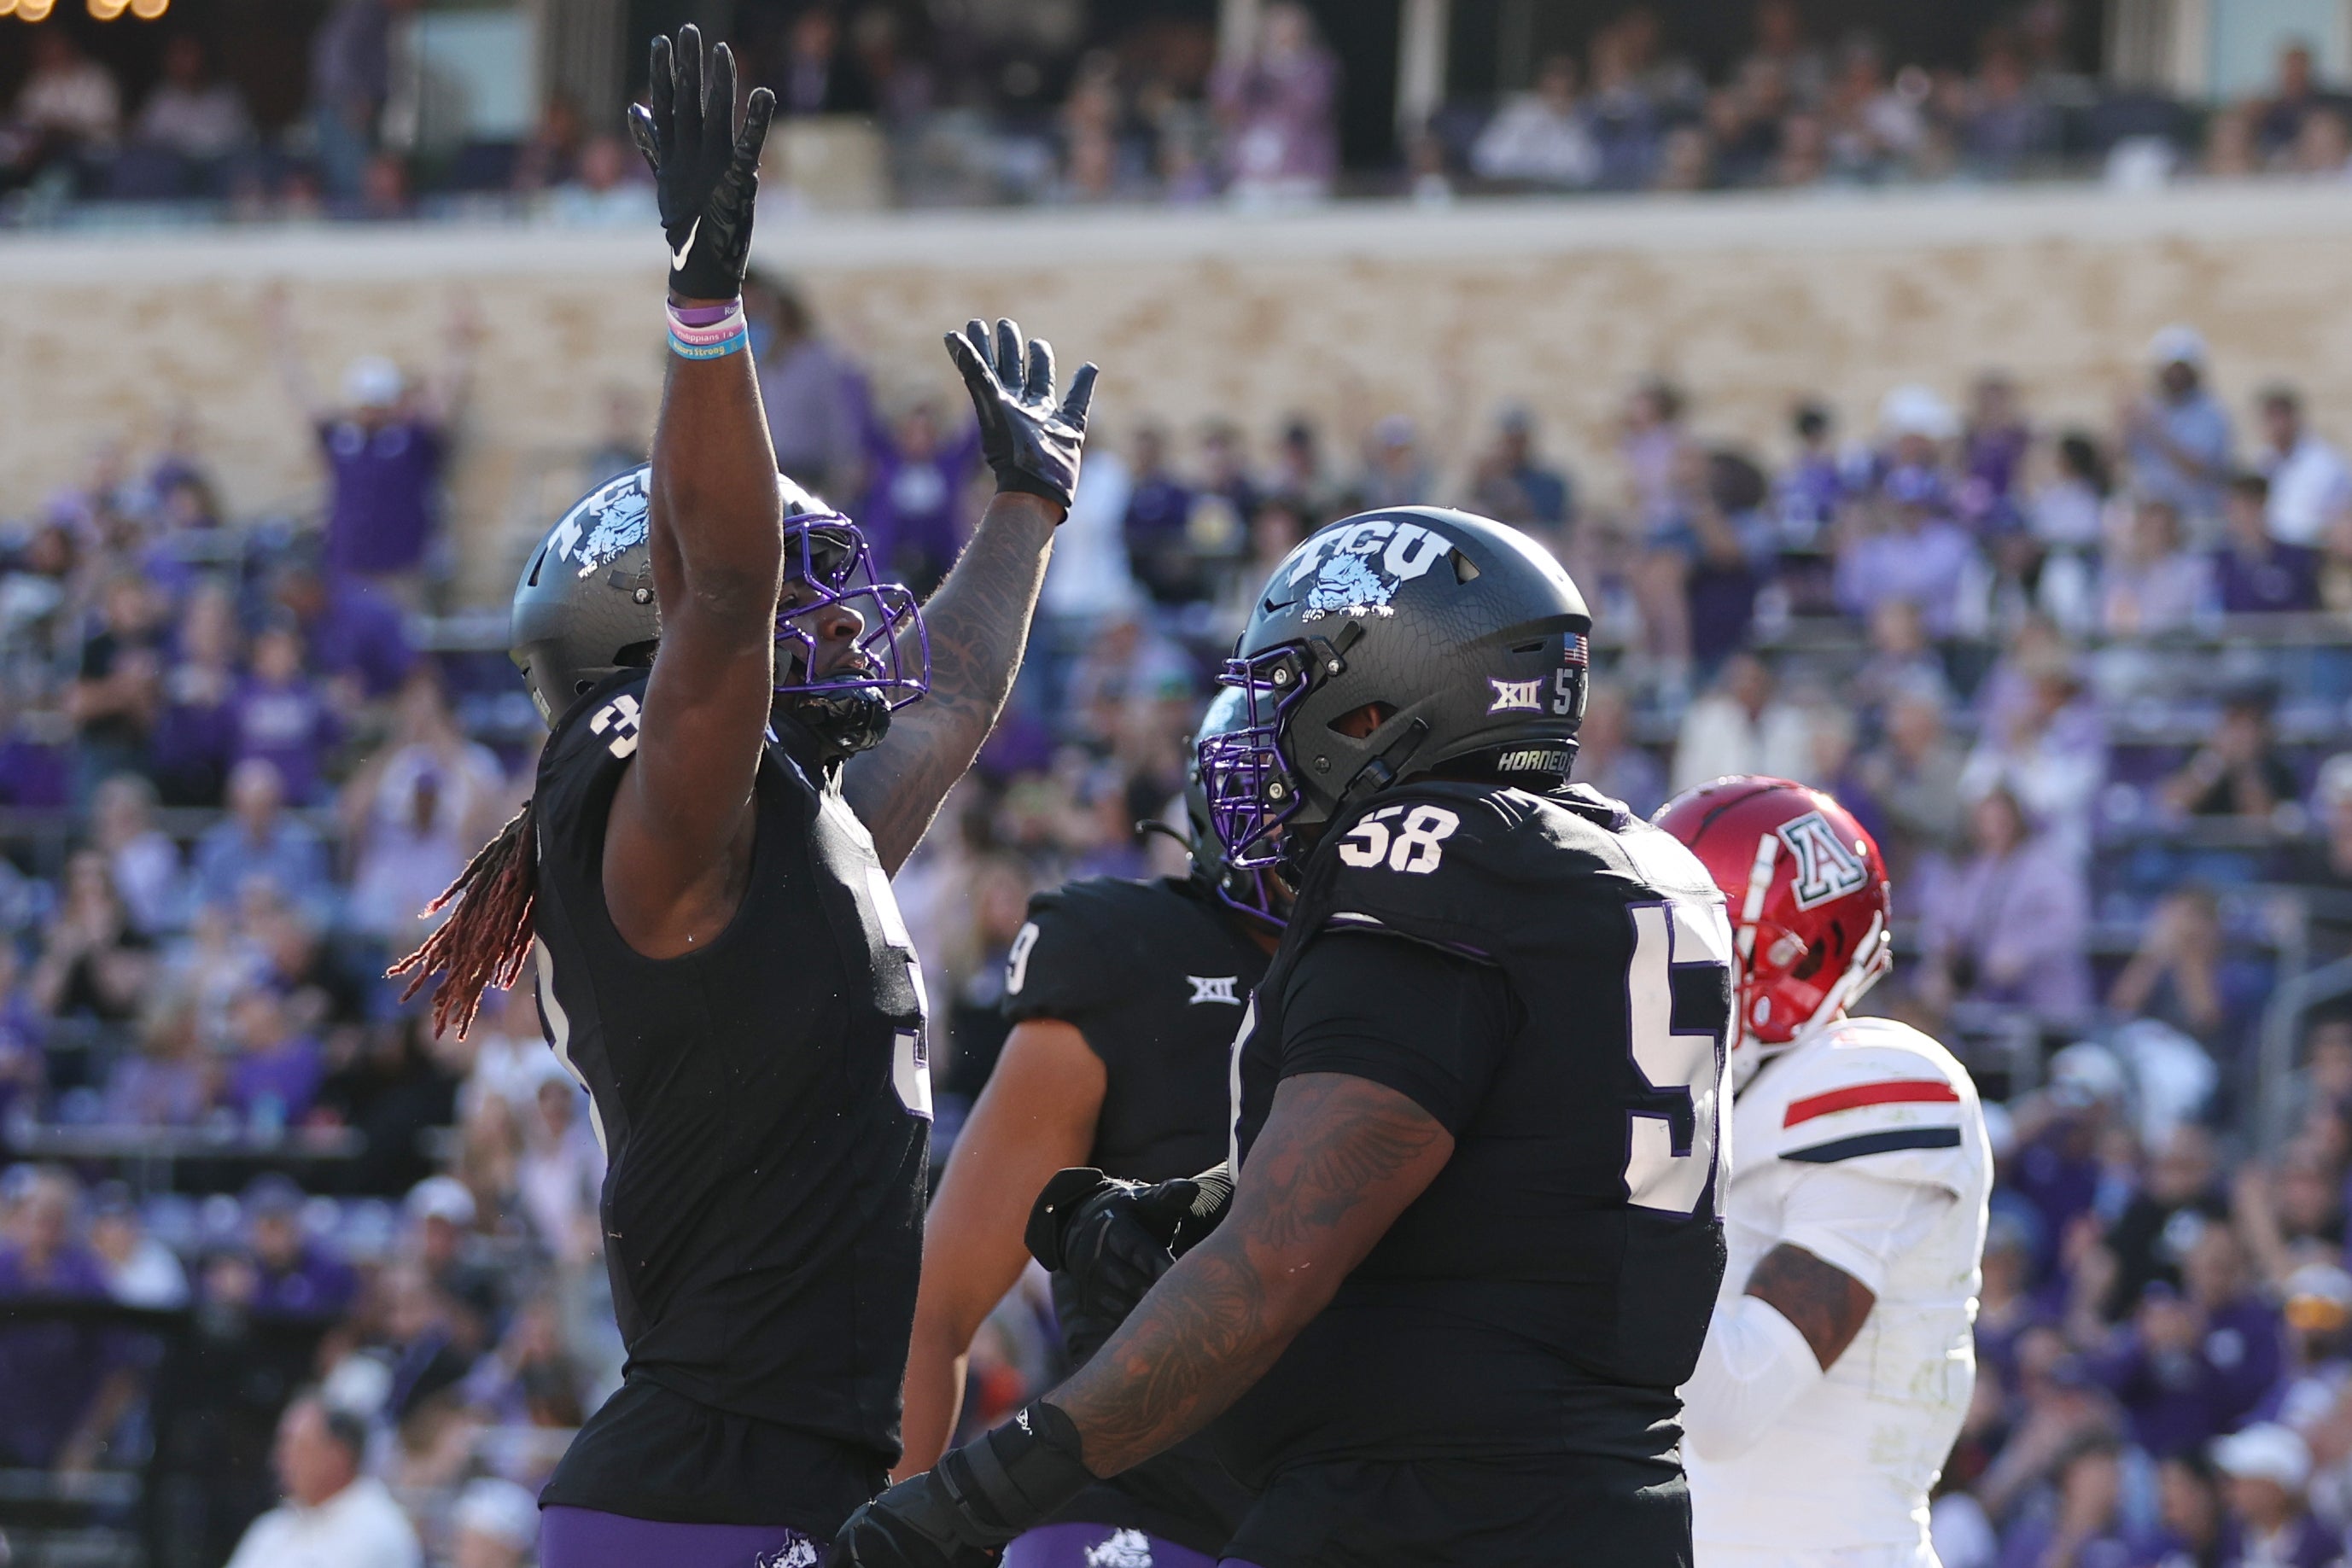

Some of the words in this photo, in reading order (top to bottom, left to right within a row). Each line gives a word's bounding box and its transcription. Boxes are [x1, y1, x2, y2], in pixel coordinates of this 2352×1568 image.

[1288, 521, 1455, 584] TCU
[1497, 750, 1569, 772] HORNED
[1338, 805, 1460, 874] 58
[1776, 810, 1868, 912] A
[1624, 901, 1733, 1221] 5
